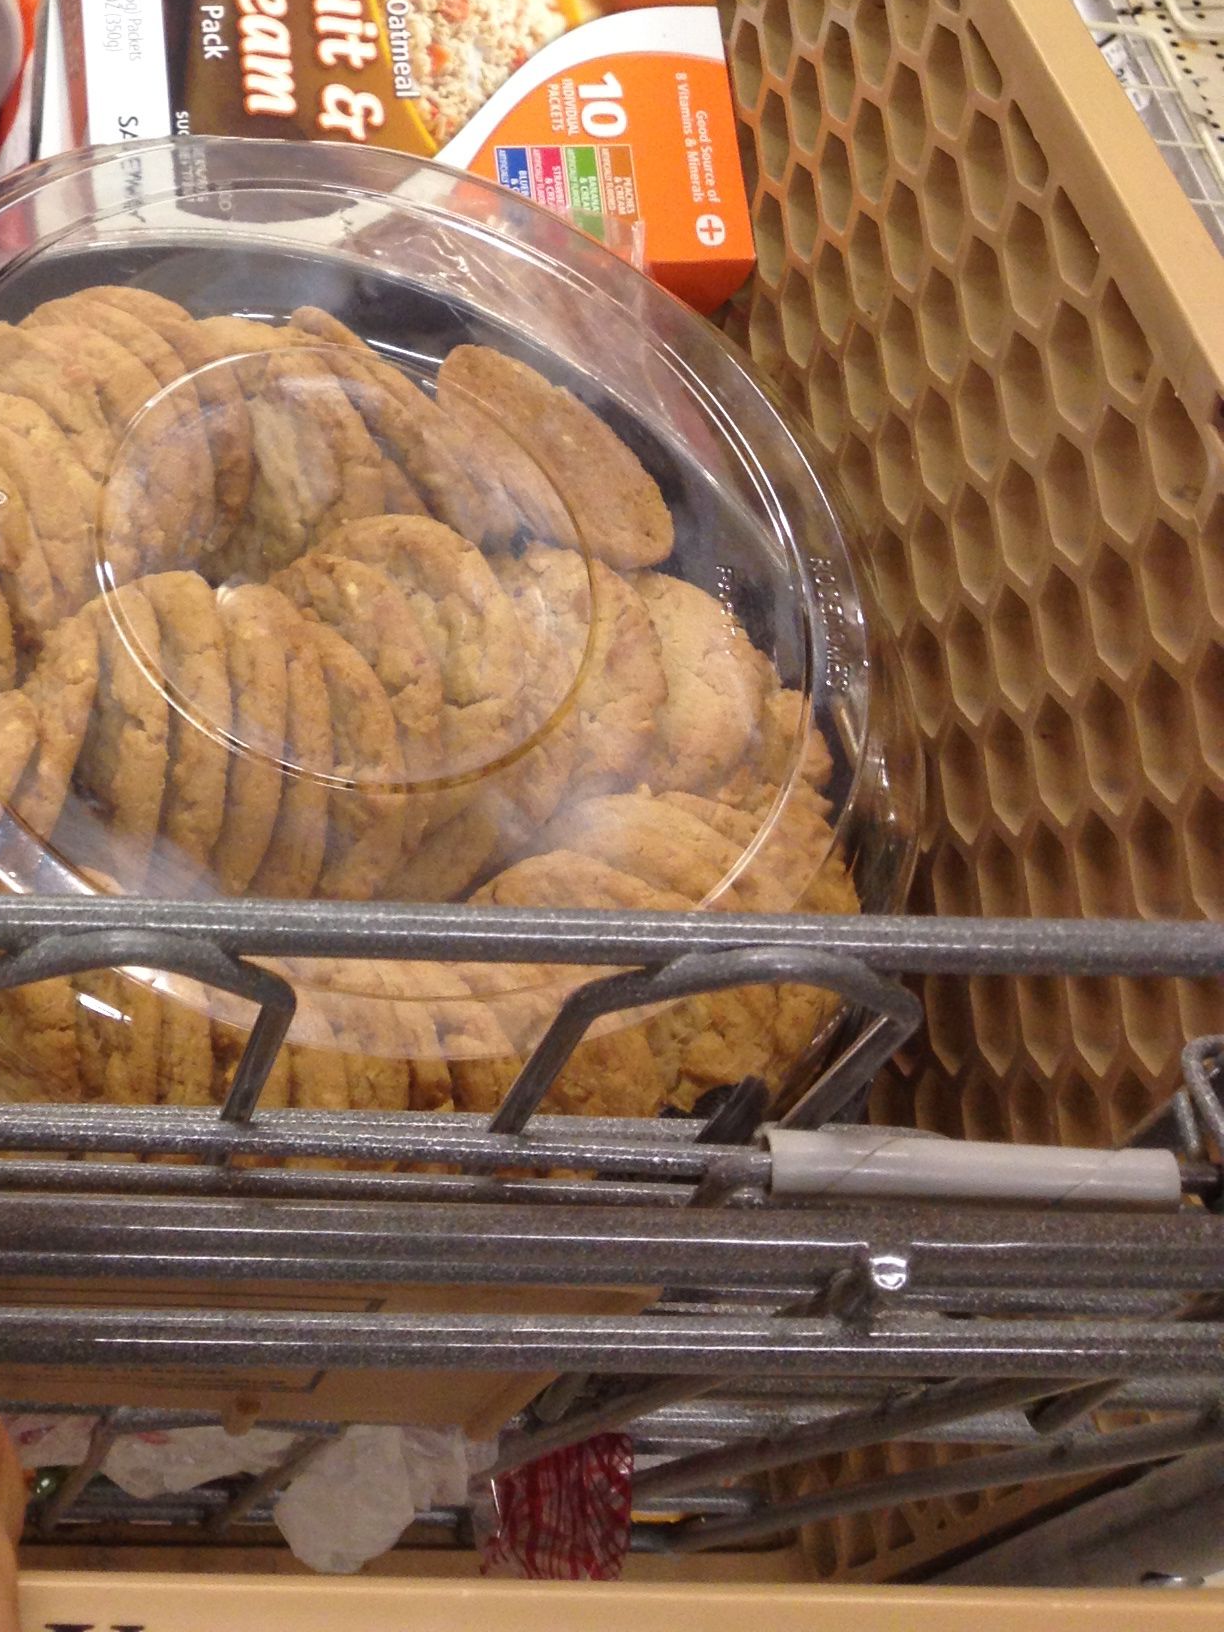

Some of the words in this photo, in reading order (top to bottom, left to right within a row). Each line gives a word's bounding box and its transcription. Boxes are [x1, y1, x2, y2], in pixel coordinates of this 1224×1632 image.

[199, 5, 230, 60] Pack
[675, 72, 688, 80] 8
[317, 83, 385, 142] &
[547, 83, 564, 132] PACKETS
[562, 78, 580, 136] INDIVIDUAL
[577, 71, 628, 138] 10
[676, 82, 693, 135] Vitamins
[684, 137, 697, 148] &
[695, 110, 713, 144] Good
[686, 151, 705, 204] Minerals
[700, 145, 715, 185] Source
[614, 186, 627, 216] CREAM
[622, 176, 636, 215] PEACHES
[706, 189, 721, 204] of
